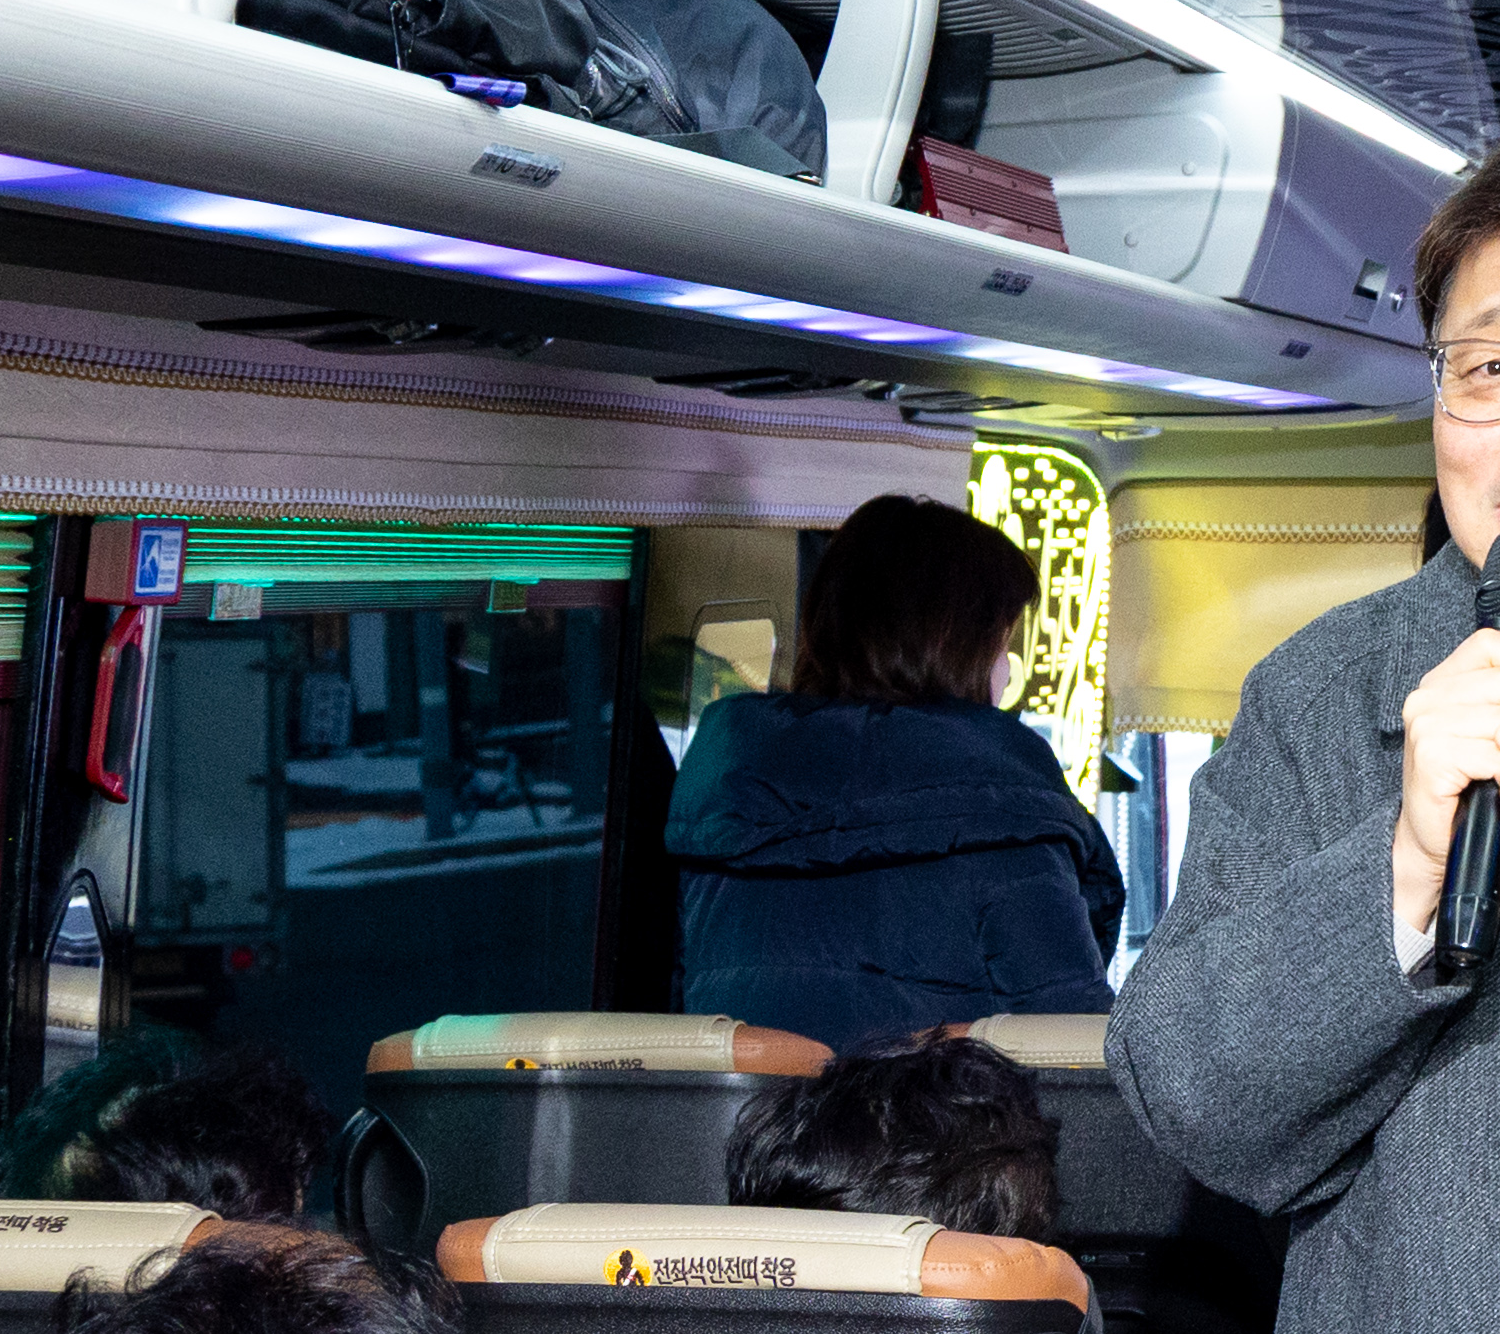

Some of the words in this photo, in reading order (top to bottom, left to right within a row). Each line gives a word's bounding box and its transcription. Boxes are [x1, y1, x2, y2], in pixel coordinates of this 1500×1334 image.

[653, 1256, 706, 1285] 전좌석
[706, 1255, 759, 1286] 안전띠
[760, 1256, 797, 1288] 착용
